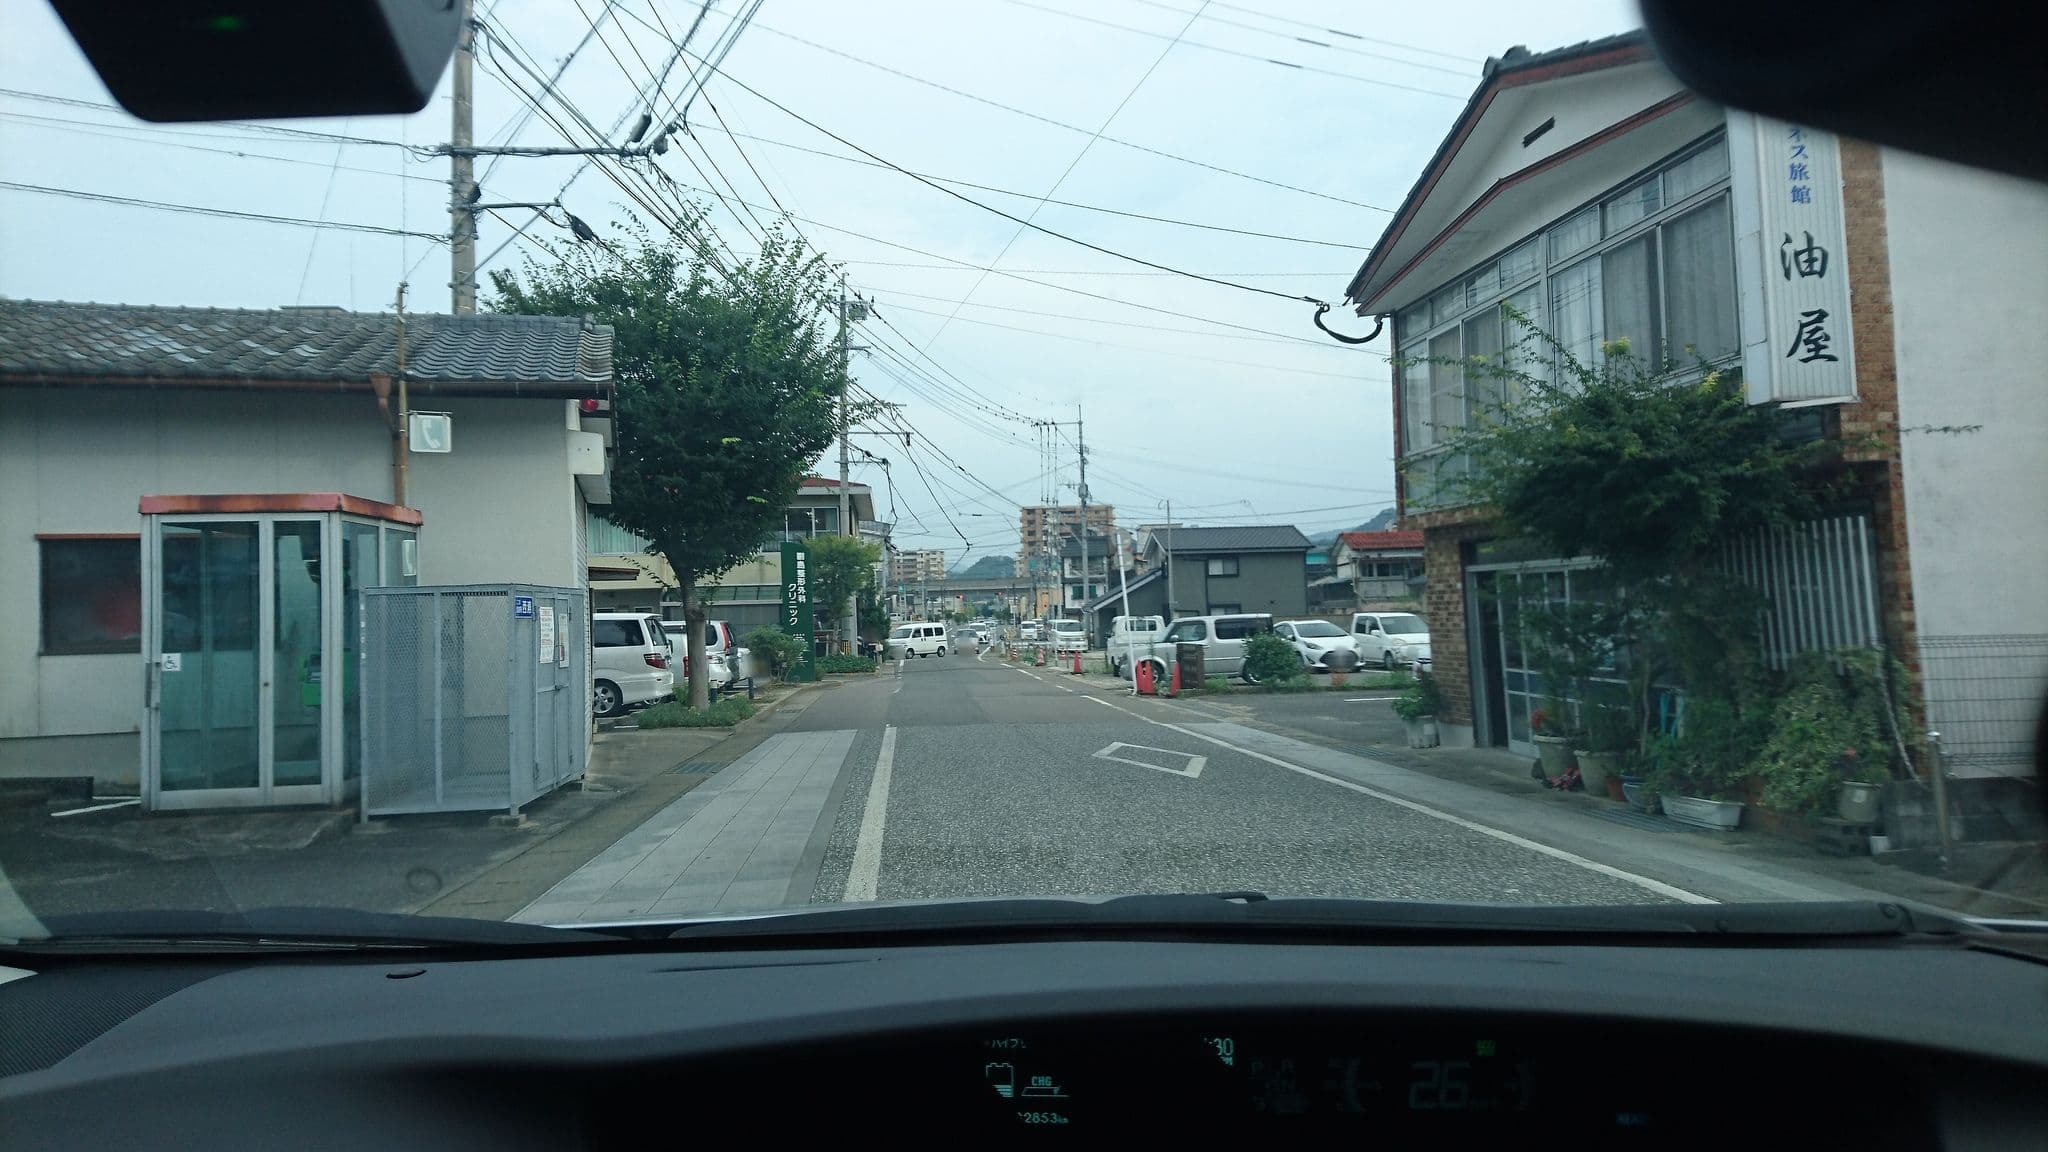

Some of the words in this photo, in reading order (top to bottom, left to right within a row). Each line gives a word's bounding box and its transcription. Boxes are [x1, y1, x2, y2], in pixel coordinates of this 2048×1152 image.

[1780, 230, 1839, 364] 油屋
[788, 583, 798, 626] クリニック
[1031, 1075, 1053, 1087] CHG
